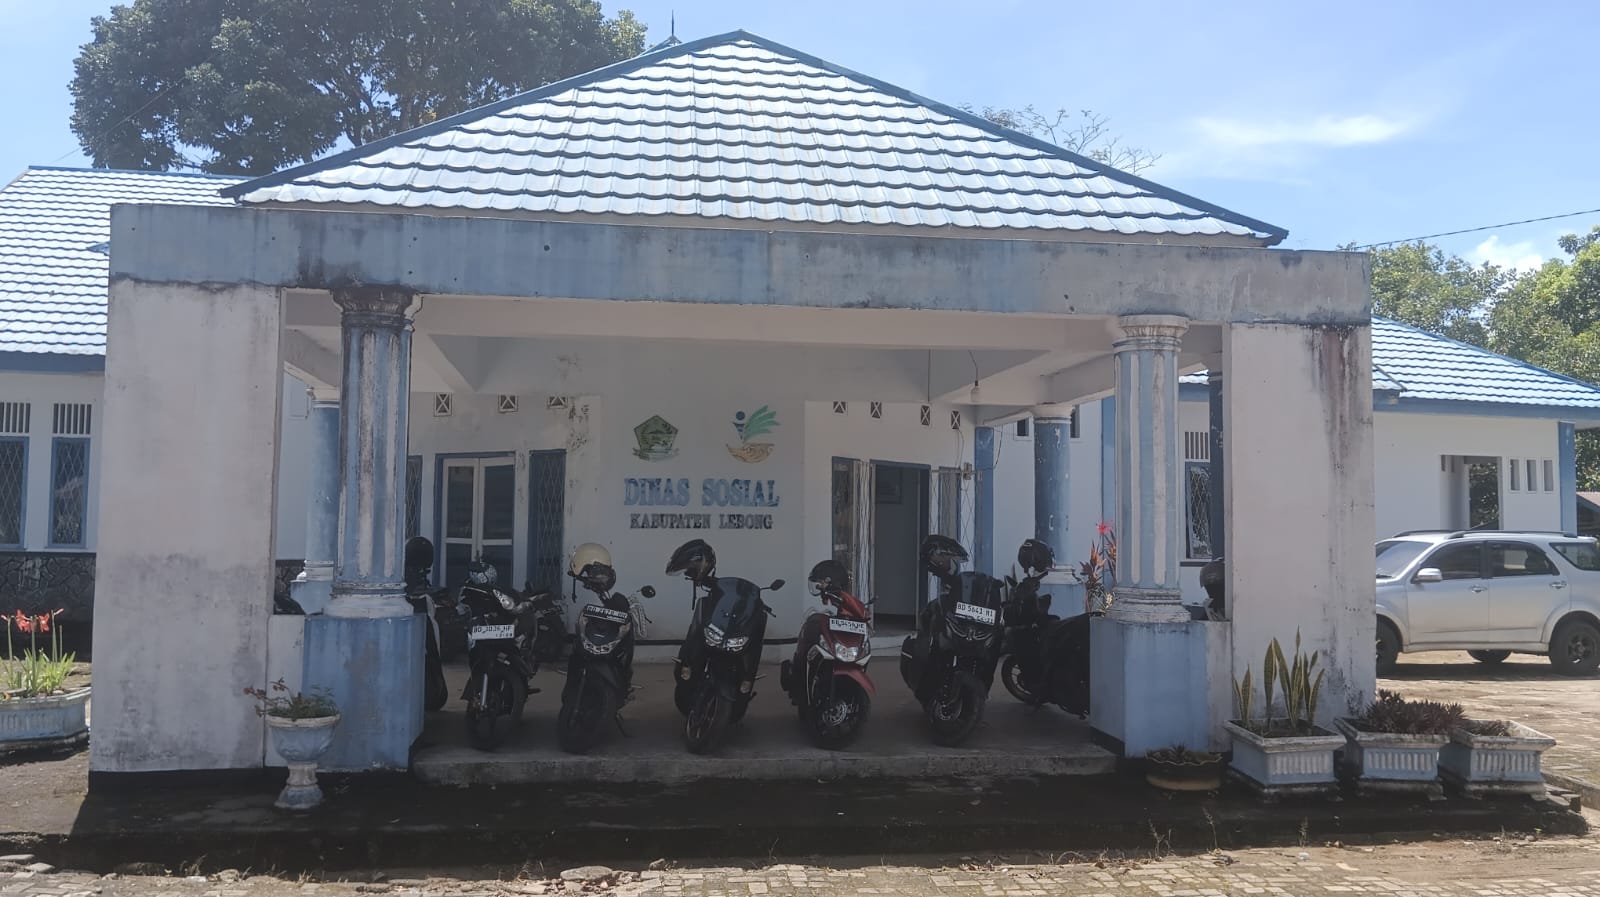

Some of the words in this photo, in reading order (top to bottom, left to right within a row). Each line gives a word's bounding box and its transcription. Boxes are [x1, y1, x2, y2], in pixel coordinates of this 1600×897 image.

[624, 478, 690, 506] DINAS
[702, 478, 780, 507] SOSIAL
[630, 513, 711, 530] KABUPATEN
[719, 514, 774, 530] LEBONG
